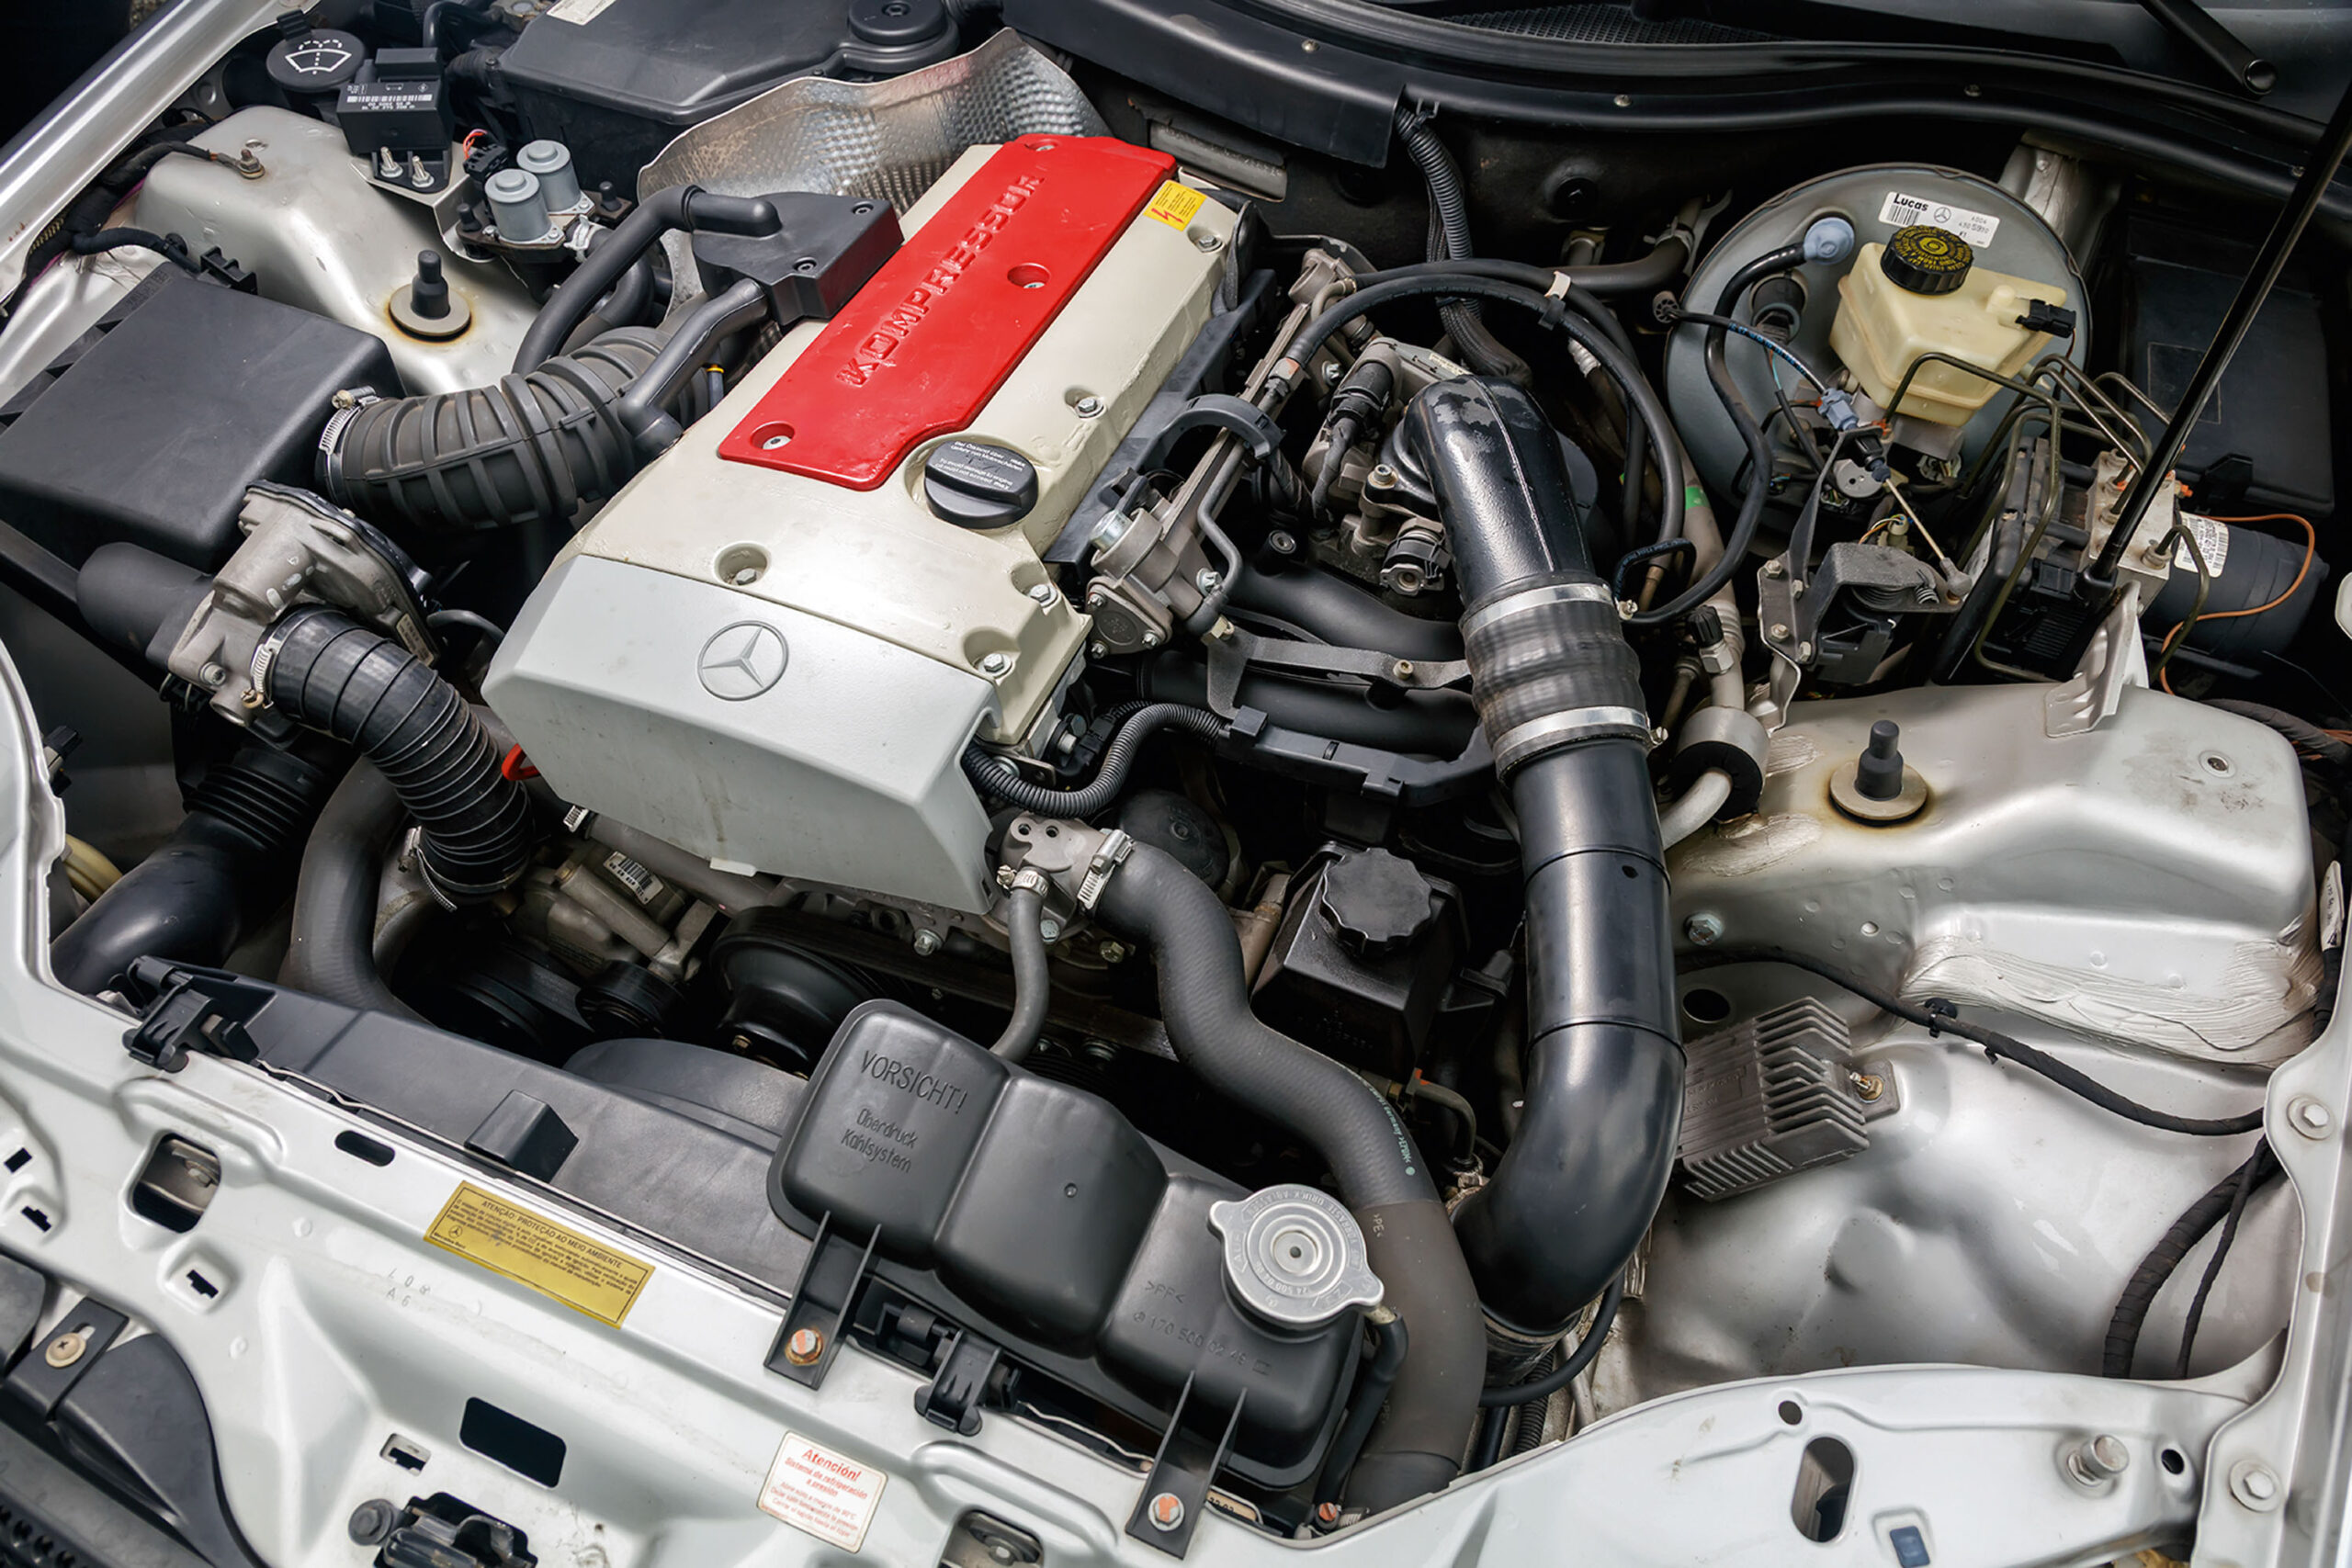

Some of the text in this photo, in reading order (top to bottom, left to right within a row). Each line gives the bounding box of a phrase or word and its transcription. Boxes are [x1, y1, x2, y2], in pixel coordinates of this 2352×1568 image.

[1894, 193, 1929, 212] Lucas
[835, 175, 1046, 388] KOMPRESSOR
[861, 1050, 968, 1115] VORSICHT!
[517, 1215, 556, 1238] PROTEÇÃO
[556, 1234, 568, 1244] AO
[567, 1238, 586, 1252] MEIO
[588, 1248, 623, 1269] AMBIENTE
[1150, 1315, 1175, 1336] 170
[801, 1449, 863, 1482] Atención!
